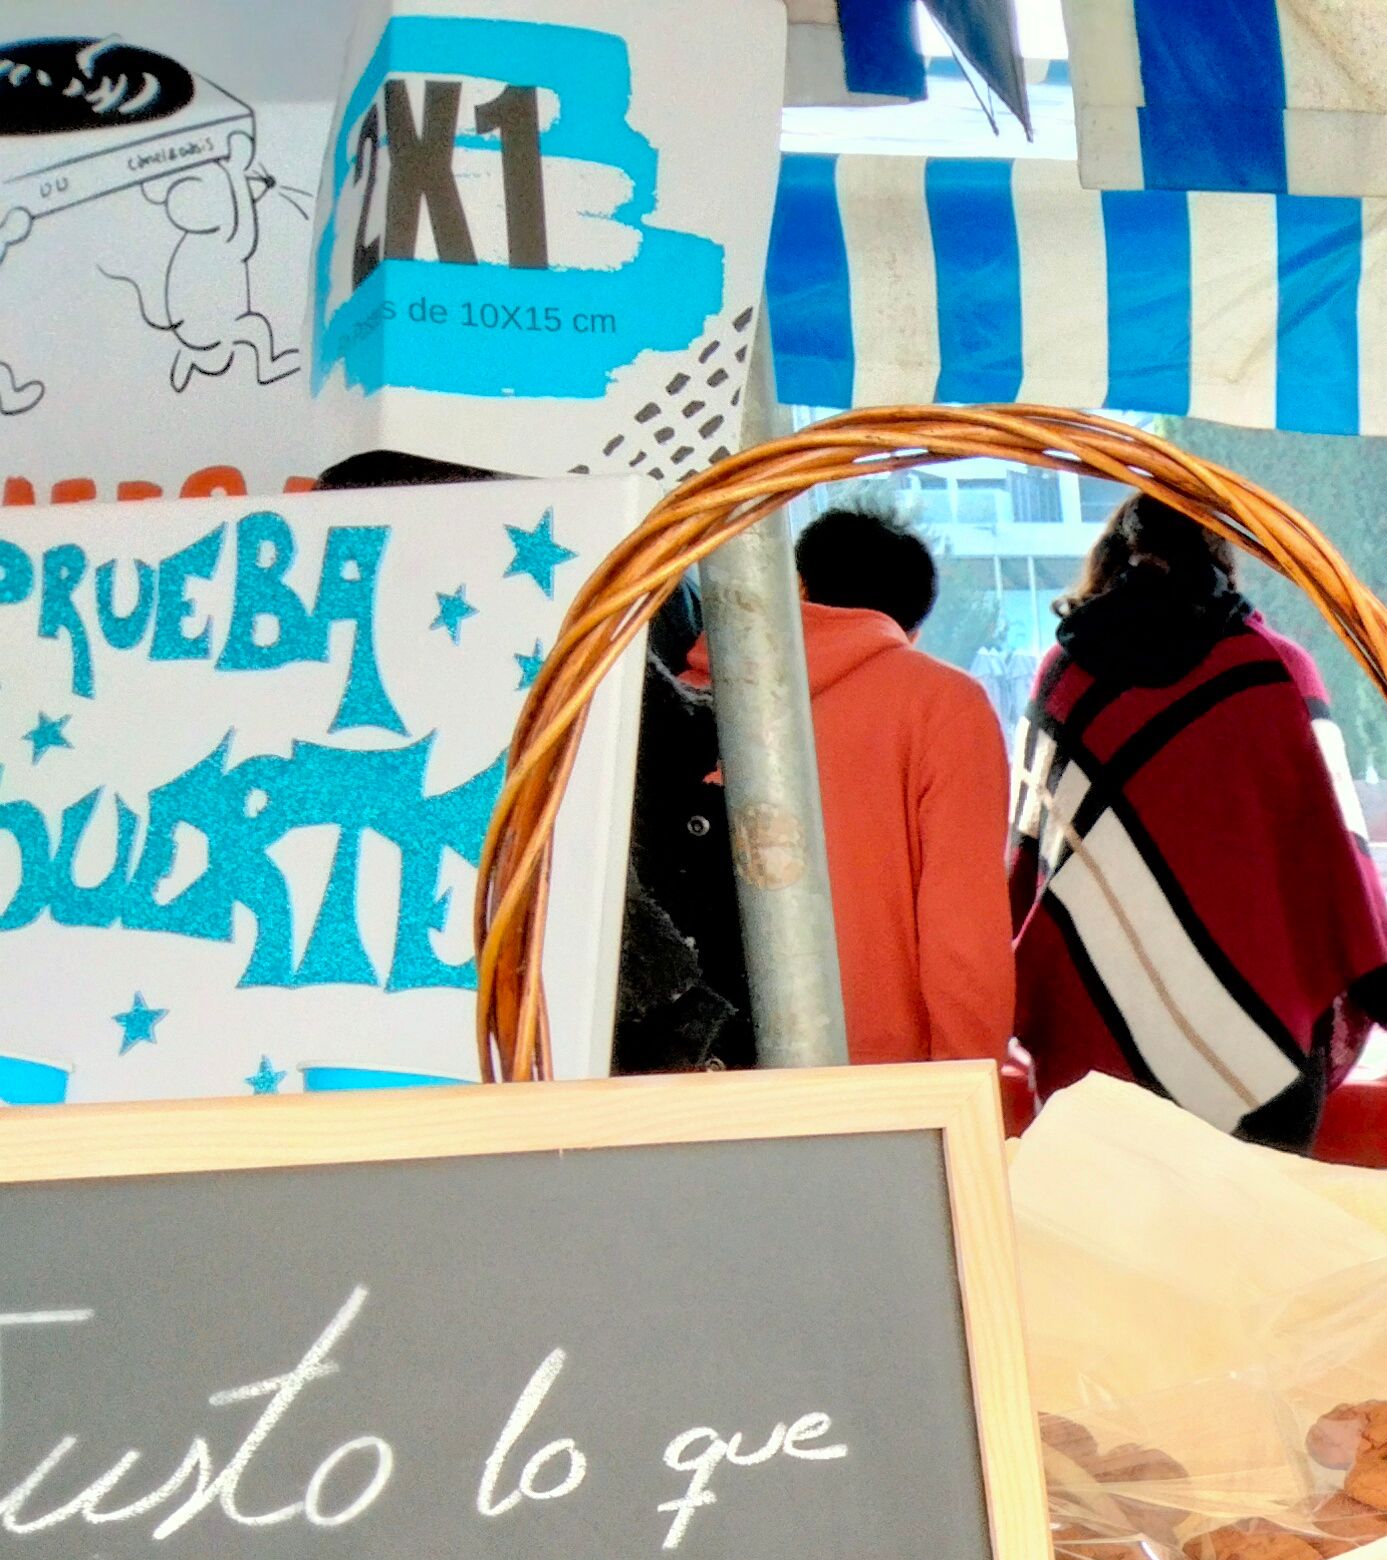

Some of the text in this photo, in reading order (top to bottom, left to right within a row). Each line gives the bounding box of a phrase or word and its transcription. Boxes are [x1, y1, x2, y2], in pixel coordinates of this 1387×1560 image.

[352, 79, 549, 293] 2X1
[409, 297, 617, 334] de 10X15 cm
[476, 1348, 587, 1518] lo
[655, 1408, 849, 1551] que
